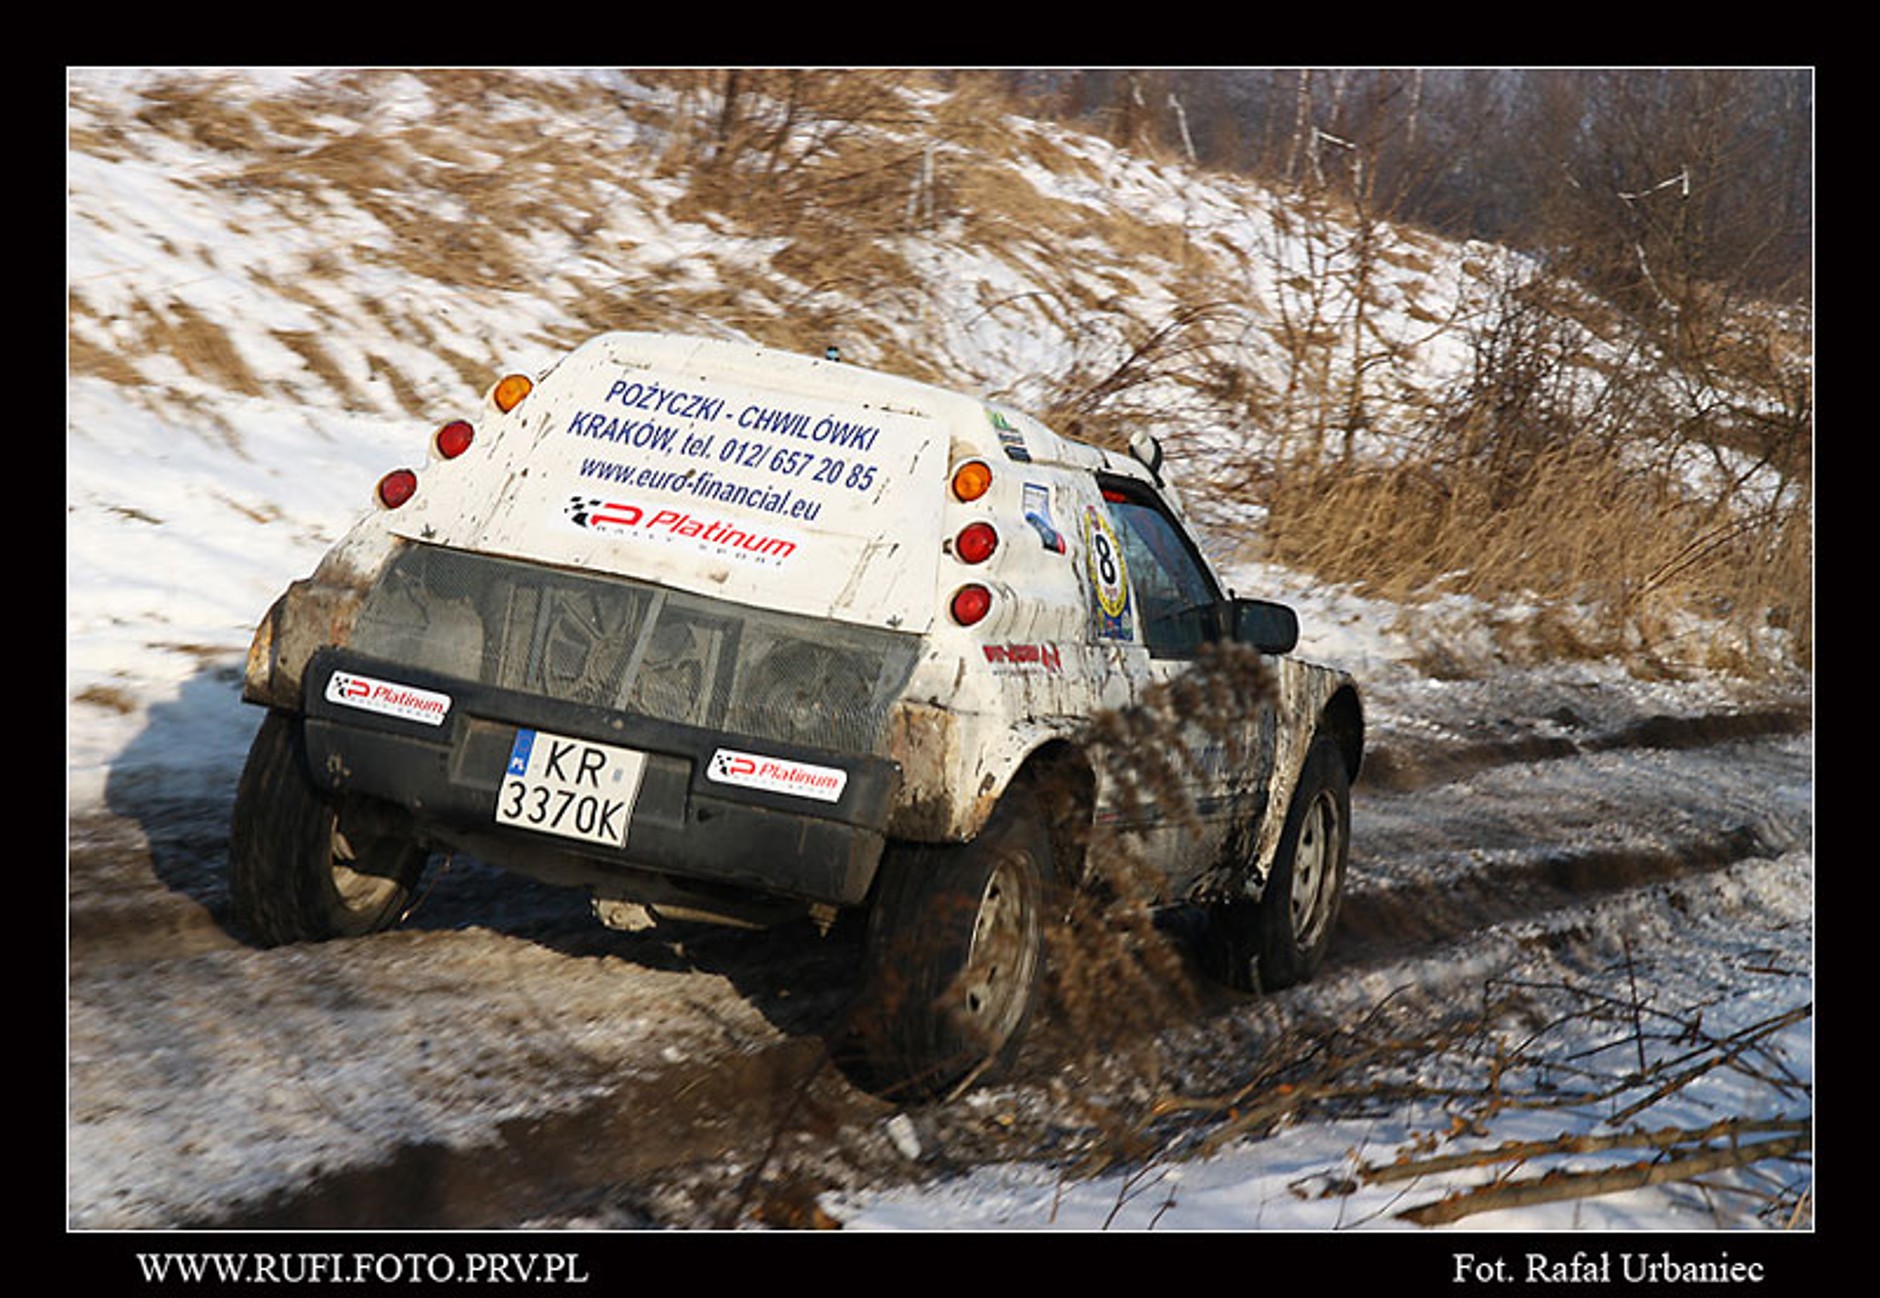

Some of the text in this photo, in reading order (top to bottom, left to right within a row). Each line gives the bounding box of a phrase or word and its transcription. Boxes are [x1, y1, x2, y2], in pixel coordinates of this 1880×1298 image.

[604, 380, 725, 422] POŻYCZKI
[738, 404, 880, 452] CHWILÓWKI
[566, 410, 878, 491] KRAKÓW, tel. 012/ 657 20 85
[580, 457, 822, 522] www.euro-financial.eu
[646, 509, 798, 558] Platinum
[1094, 533, 1116, 585] 8
[372, 684, 444, 714] Platinum
[545, 740, 607, 788] KR
[759, 761, 839, 789] Platinum
[502, 780, 625, 841] 3370K
